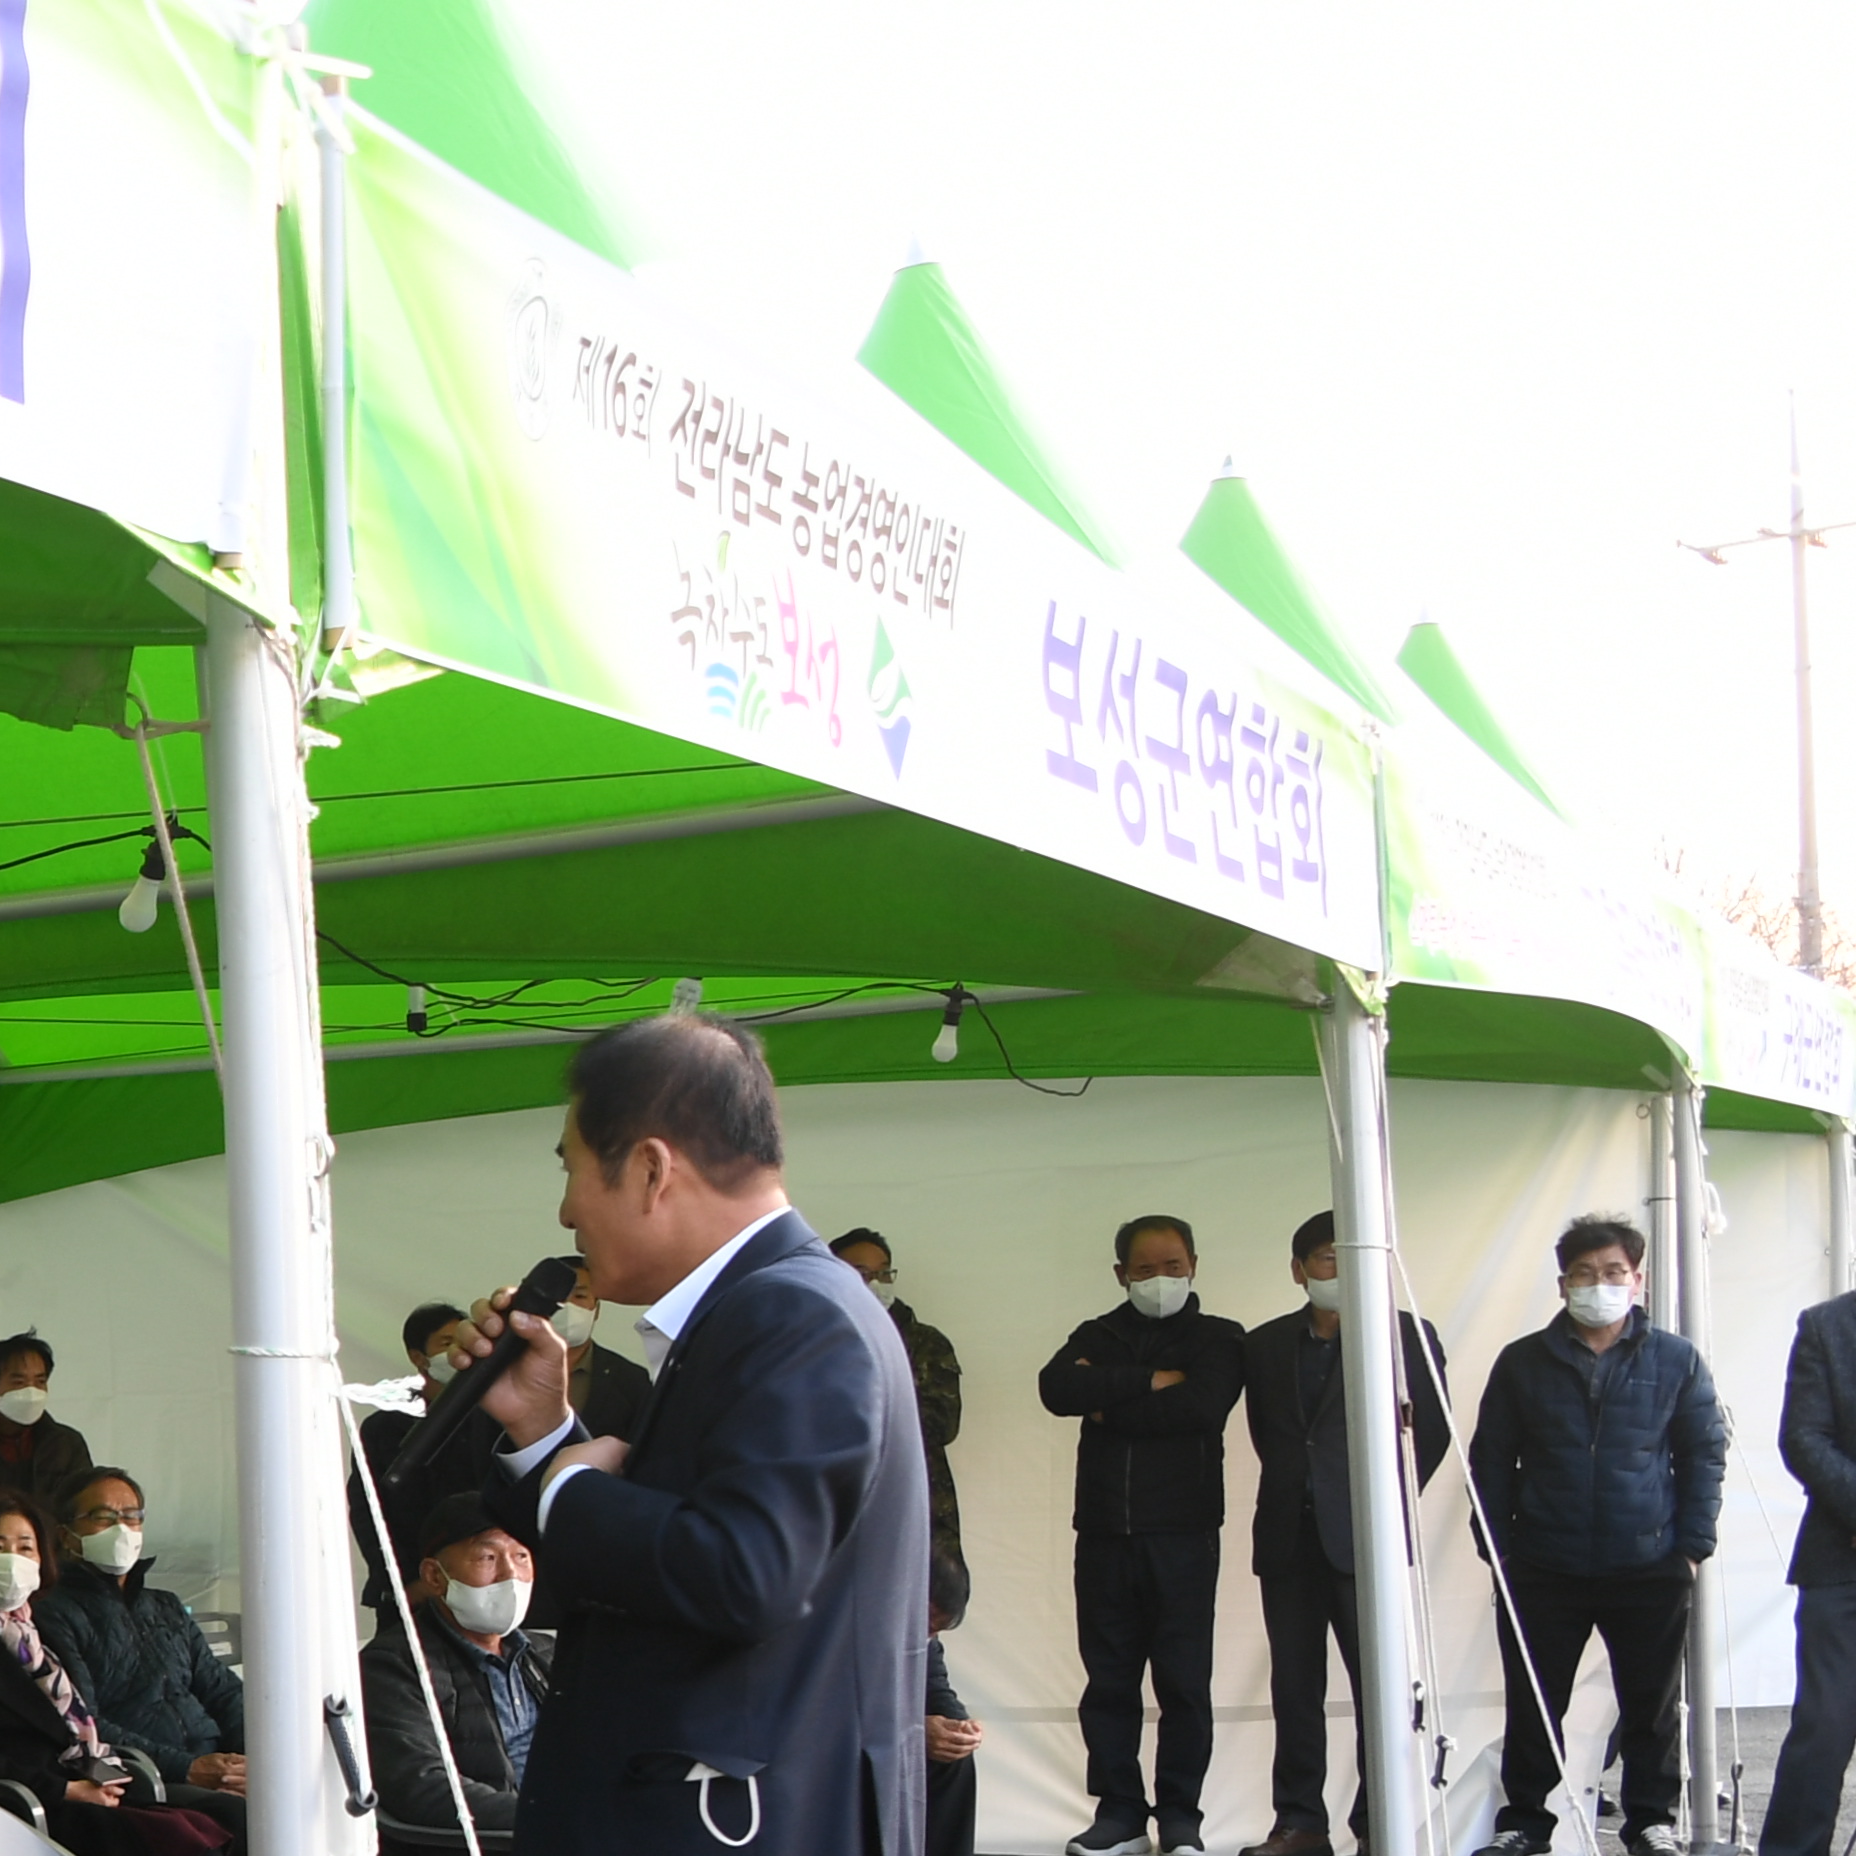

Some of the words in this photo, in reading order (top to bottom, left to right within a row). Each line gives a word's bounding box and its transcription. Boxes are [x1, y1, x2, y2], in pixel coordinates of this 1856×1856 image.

[572, 334, 662, 460] 제16회
[668, 376, 790, 528] 전라남도
[790, 440, 967, 632] 농업경영인대회
[771, 564, 843, 749] 보성
[1041, 598, 1328, 919] 보성군연합회
